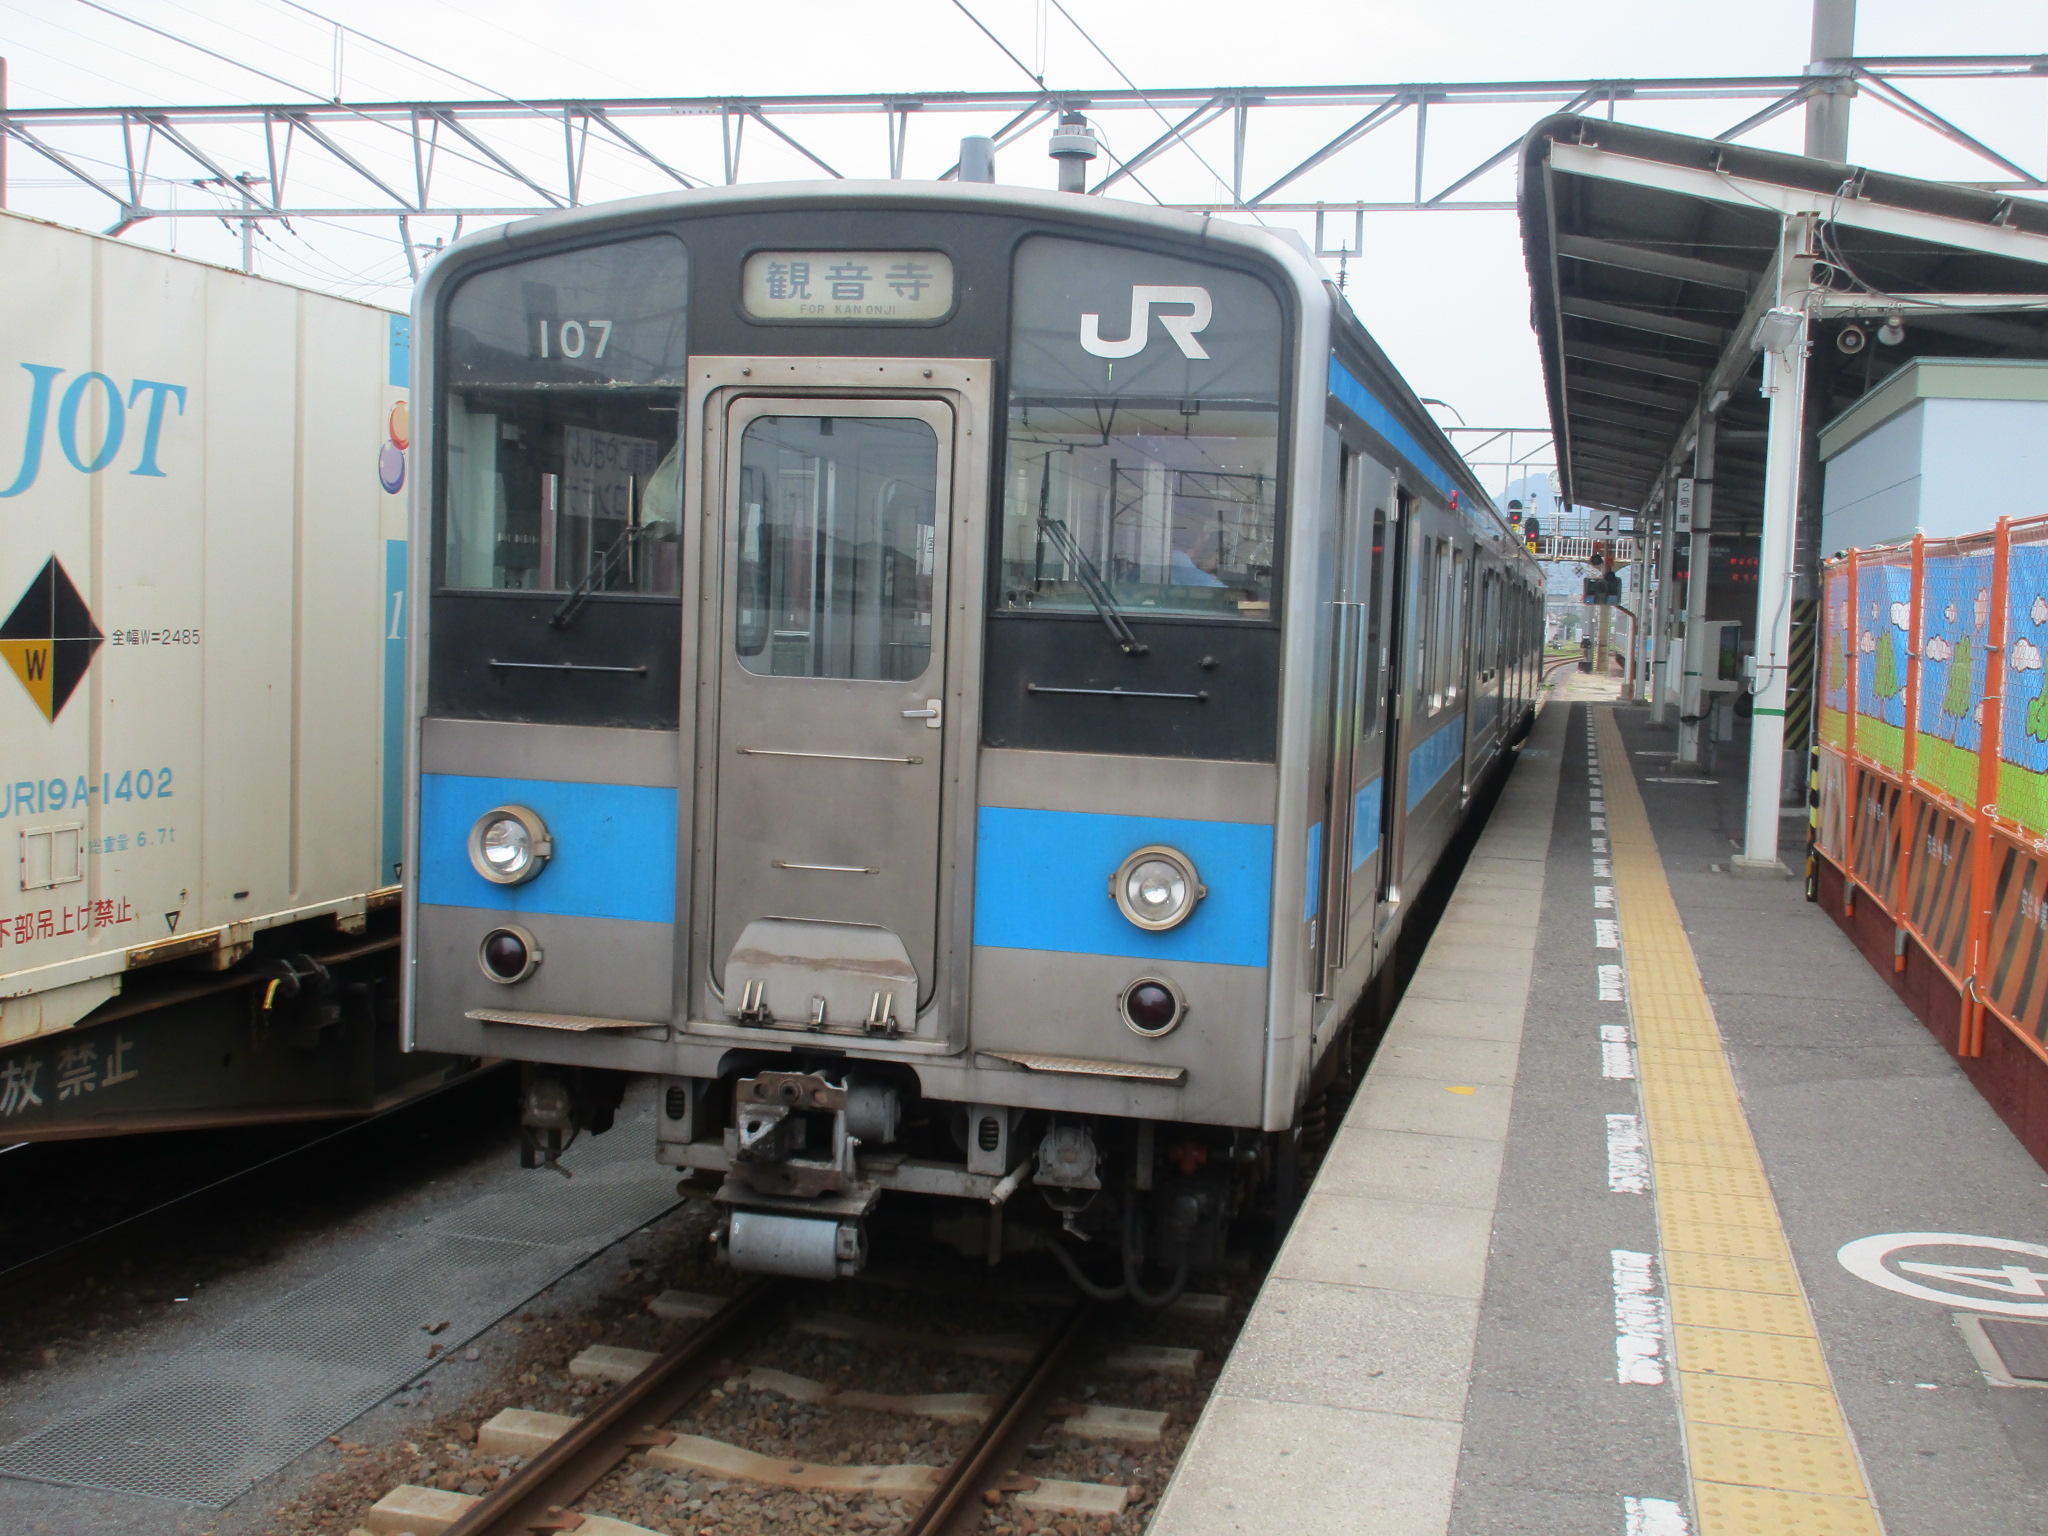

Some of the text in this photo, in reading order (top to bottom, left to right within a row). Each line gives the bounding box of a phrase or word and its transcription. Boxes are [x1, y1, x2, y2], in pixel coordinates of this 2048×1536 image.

[766, 262, 933, 301] 観音寺
[800, 304, 825, 314] FOR
[1080, 285, 1213, 360] JR
[540, 320, 612, 358] 107
[0, 363, 188, 498] JOT
[1594, 514, 1613, 535] 4
[25, 648, 47, 681] W
